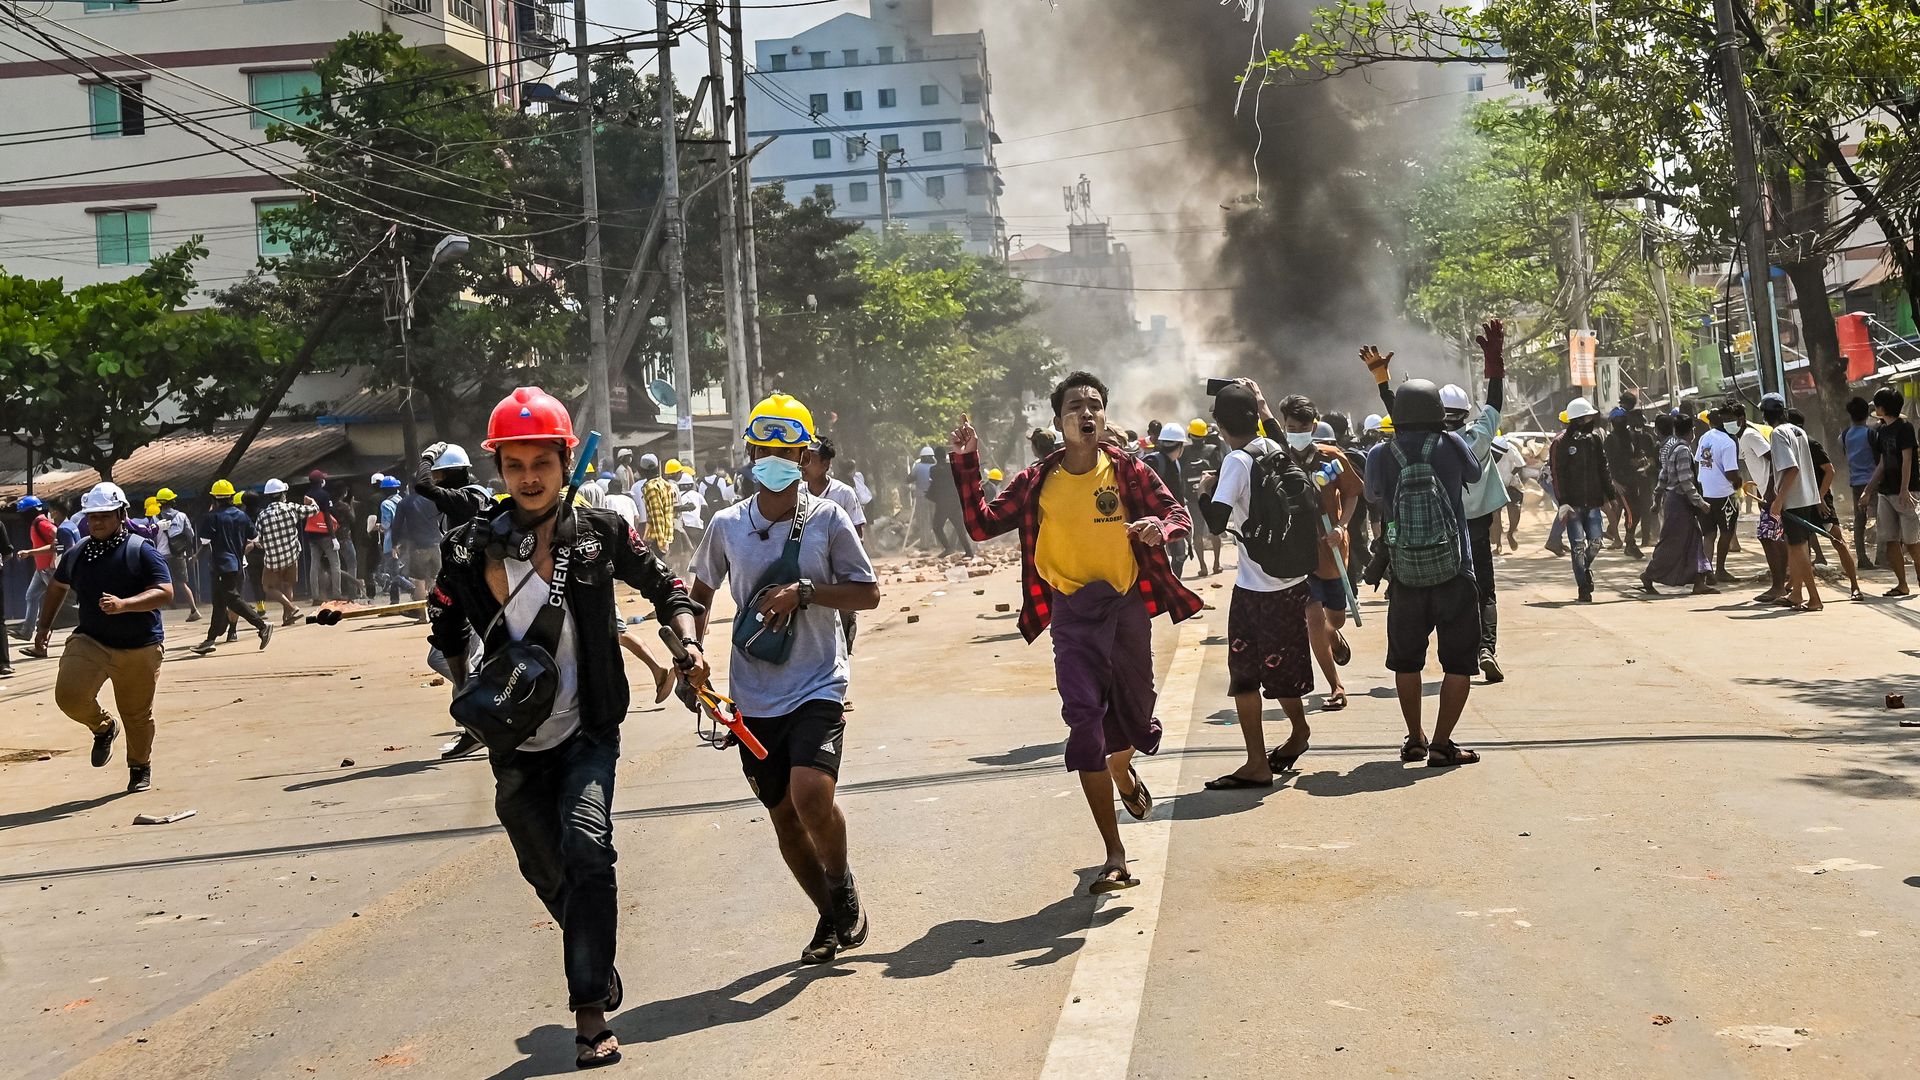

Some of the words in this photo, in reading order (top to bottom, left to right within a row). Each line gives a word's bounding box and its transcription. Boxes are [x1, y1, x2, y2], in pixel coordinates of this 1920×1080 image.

[1093, 487, 1103, 496] WE
[795, 511, 805, 529] FILA
[493, 662, 527, 706] Supreme
